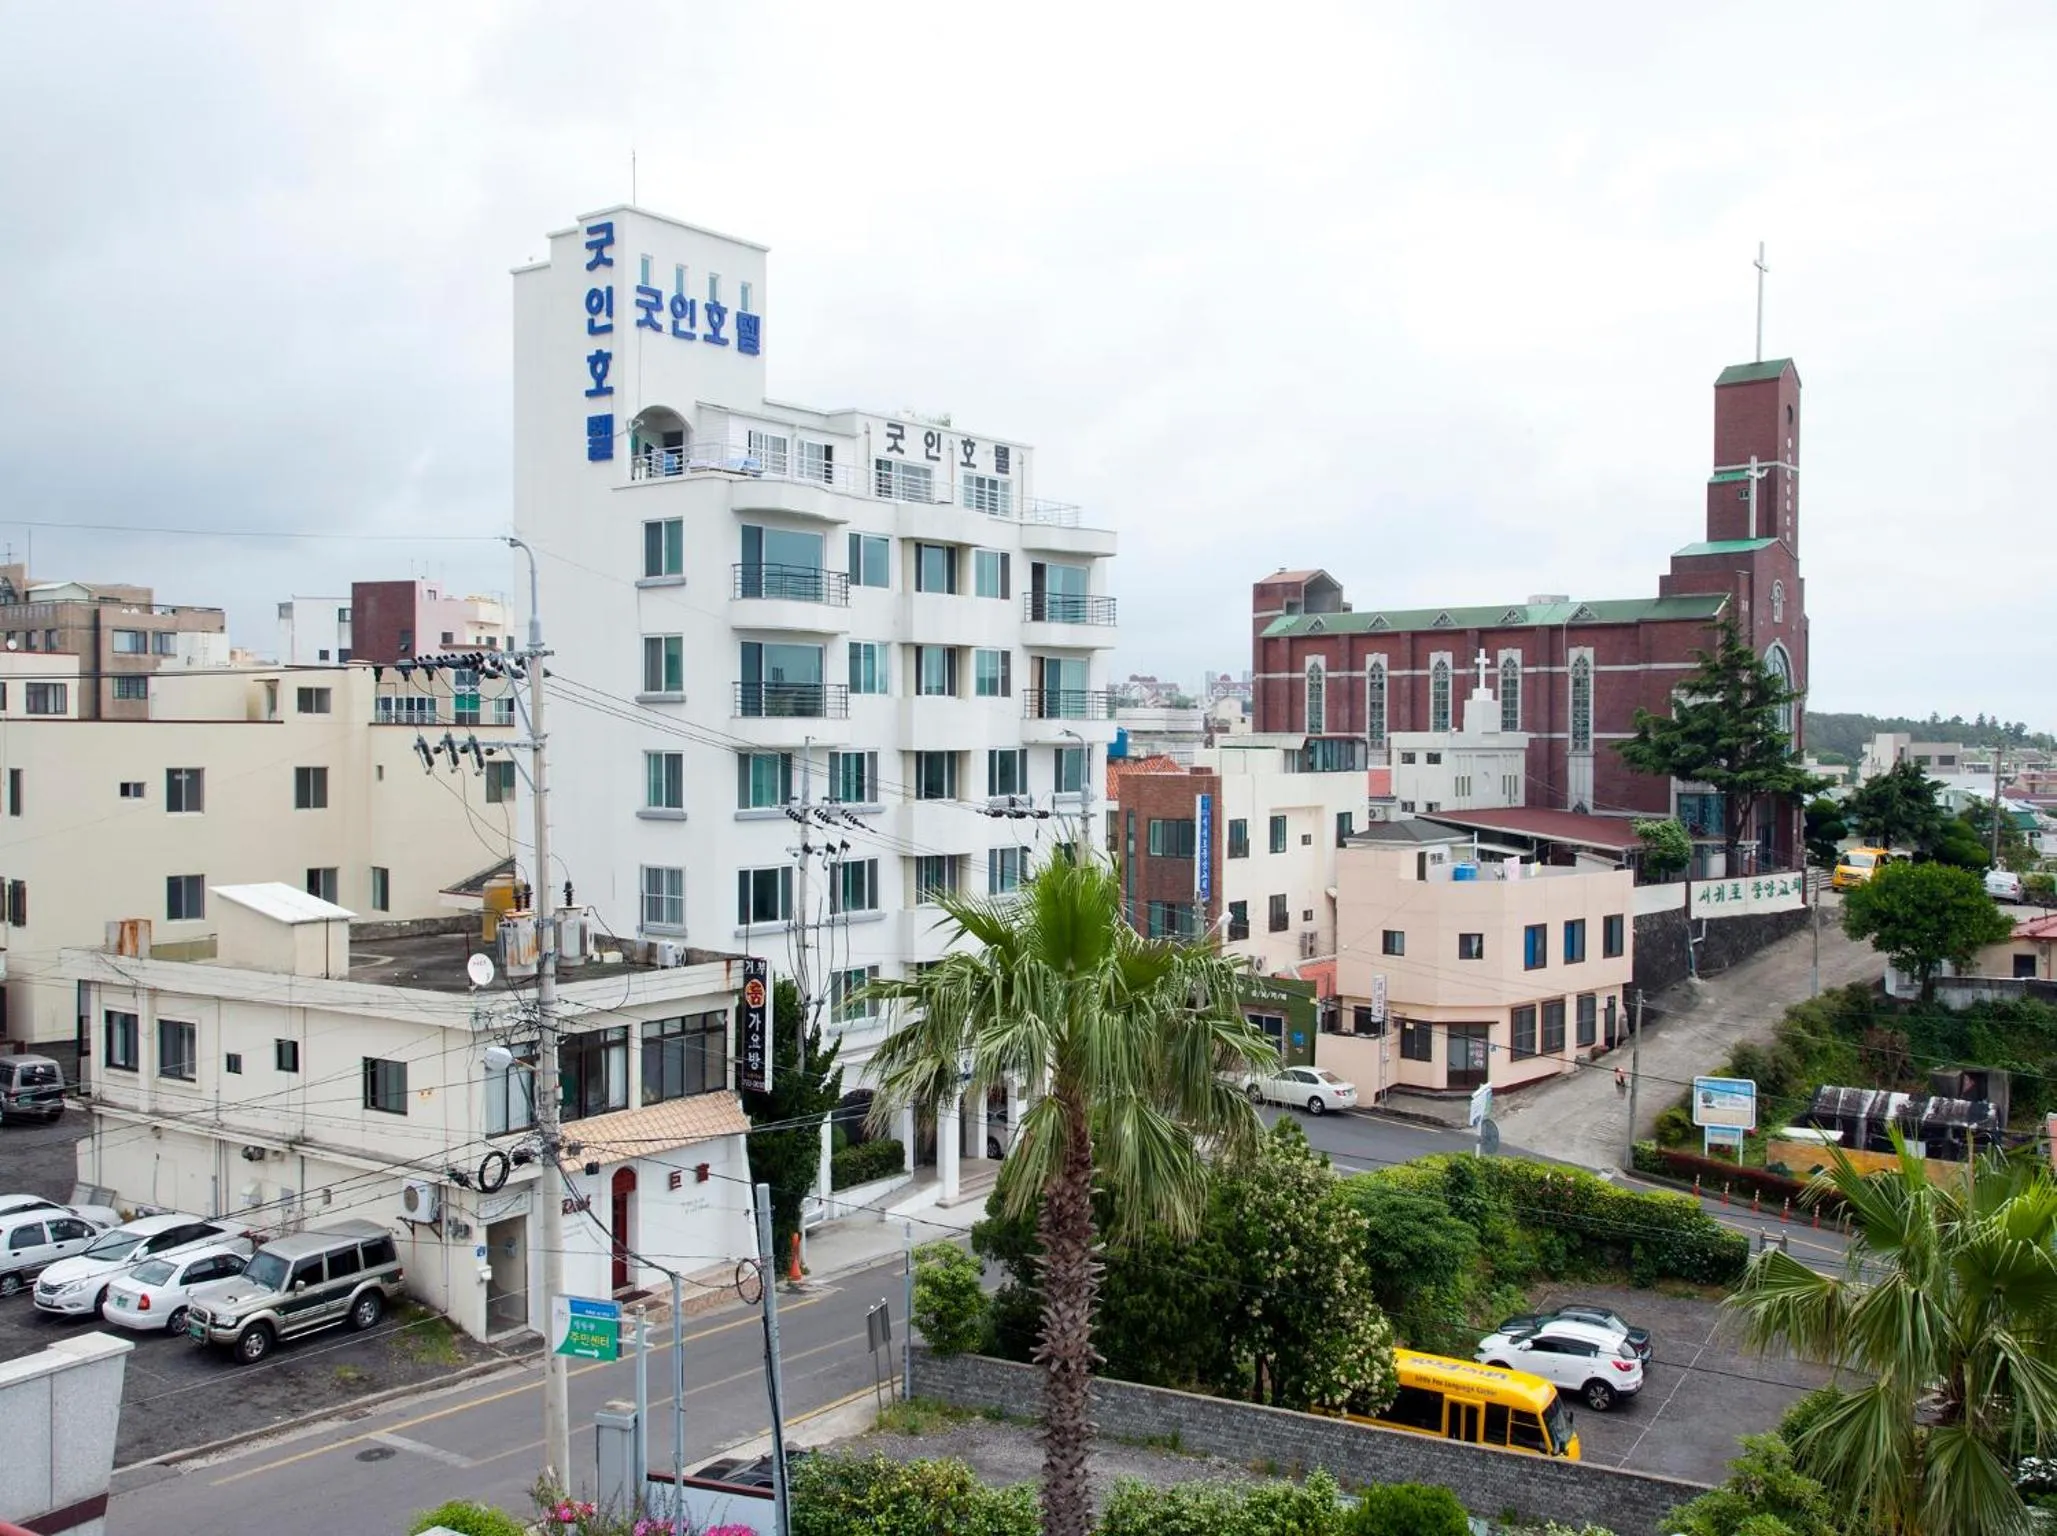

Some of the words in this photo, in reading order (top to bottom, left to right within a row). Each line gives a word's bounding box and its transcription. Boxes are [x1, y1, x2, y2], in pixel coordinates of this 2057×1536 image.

[585, 221, 615, 462] 굿인호텔
[635, 284, 761, 356] 굿인호텔
[886, 422, 1010, 475] 굿인호텔
[1698, 882, 1742, 904] 서귀포
[748, 1012, 761, 1070] 가요방
